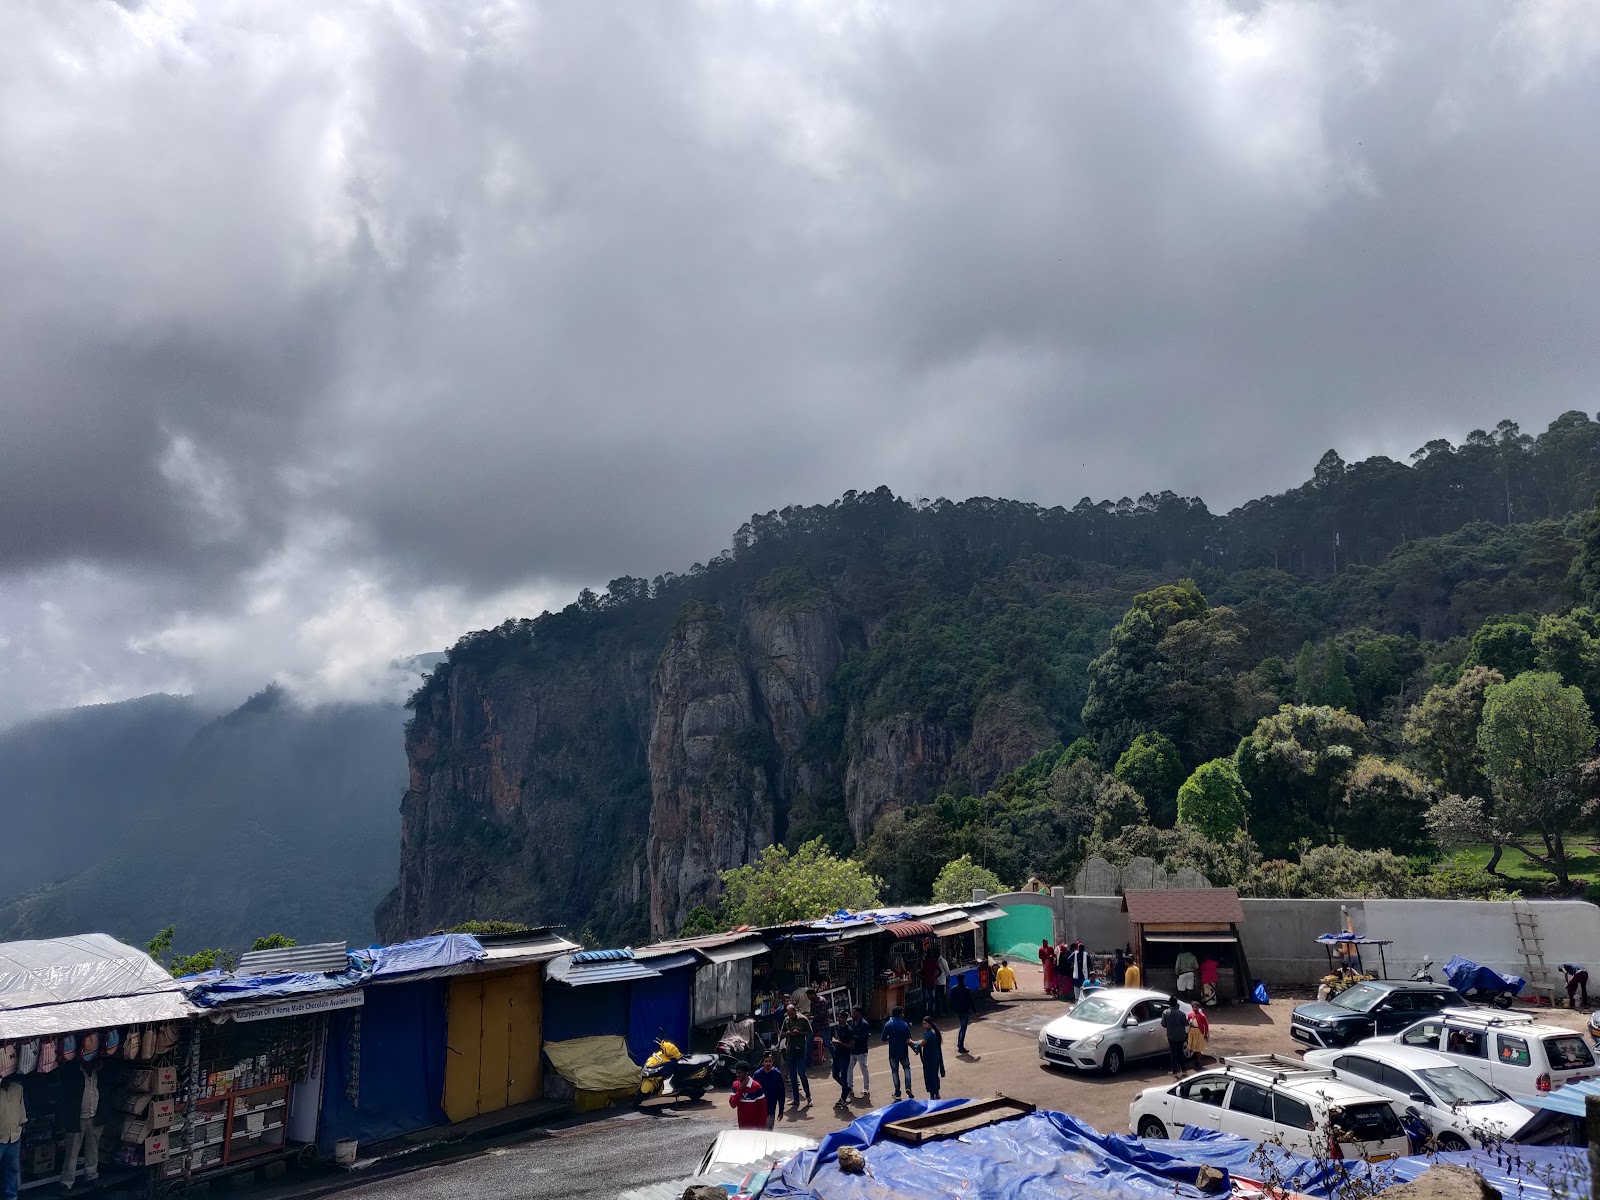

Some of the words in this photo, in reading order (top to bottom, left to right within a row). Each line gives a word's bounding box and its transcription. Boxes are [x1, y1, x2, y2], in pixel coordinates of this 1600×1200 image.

[276, 1006, 290, 1014] Home
[291, 1004, 304, 1012] Made
[305, 1001, 329, 1010] Chocolate
[329, 997, 350, 1007] Available
[350, 996, 361, 1004] Here
[148, 1148, 165, 1156] KODAI
